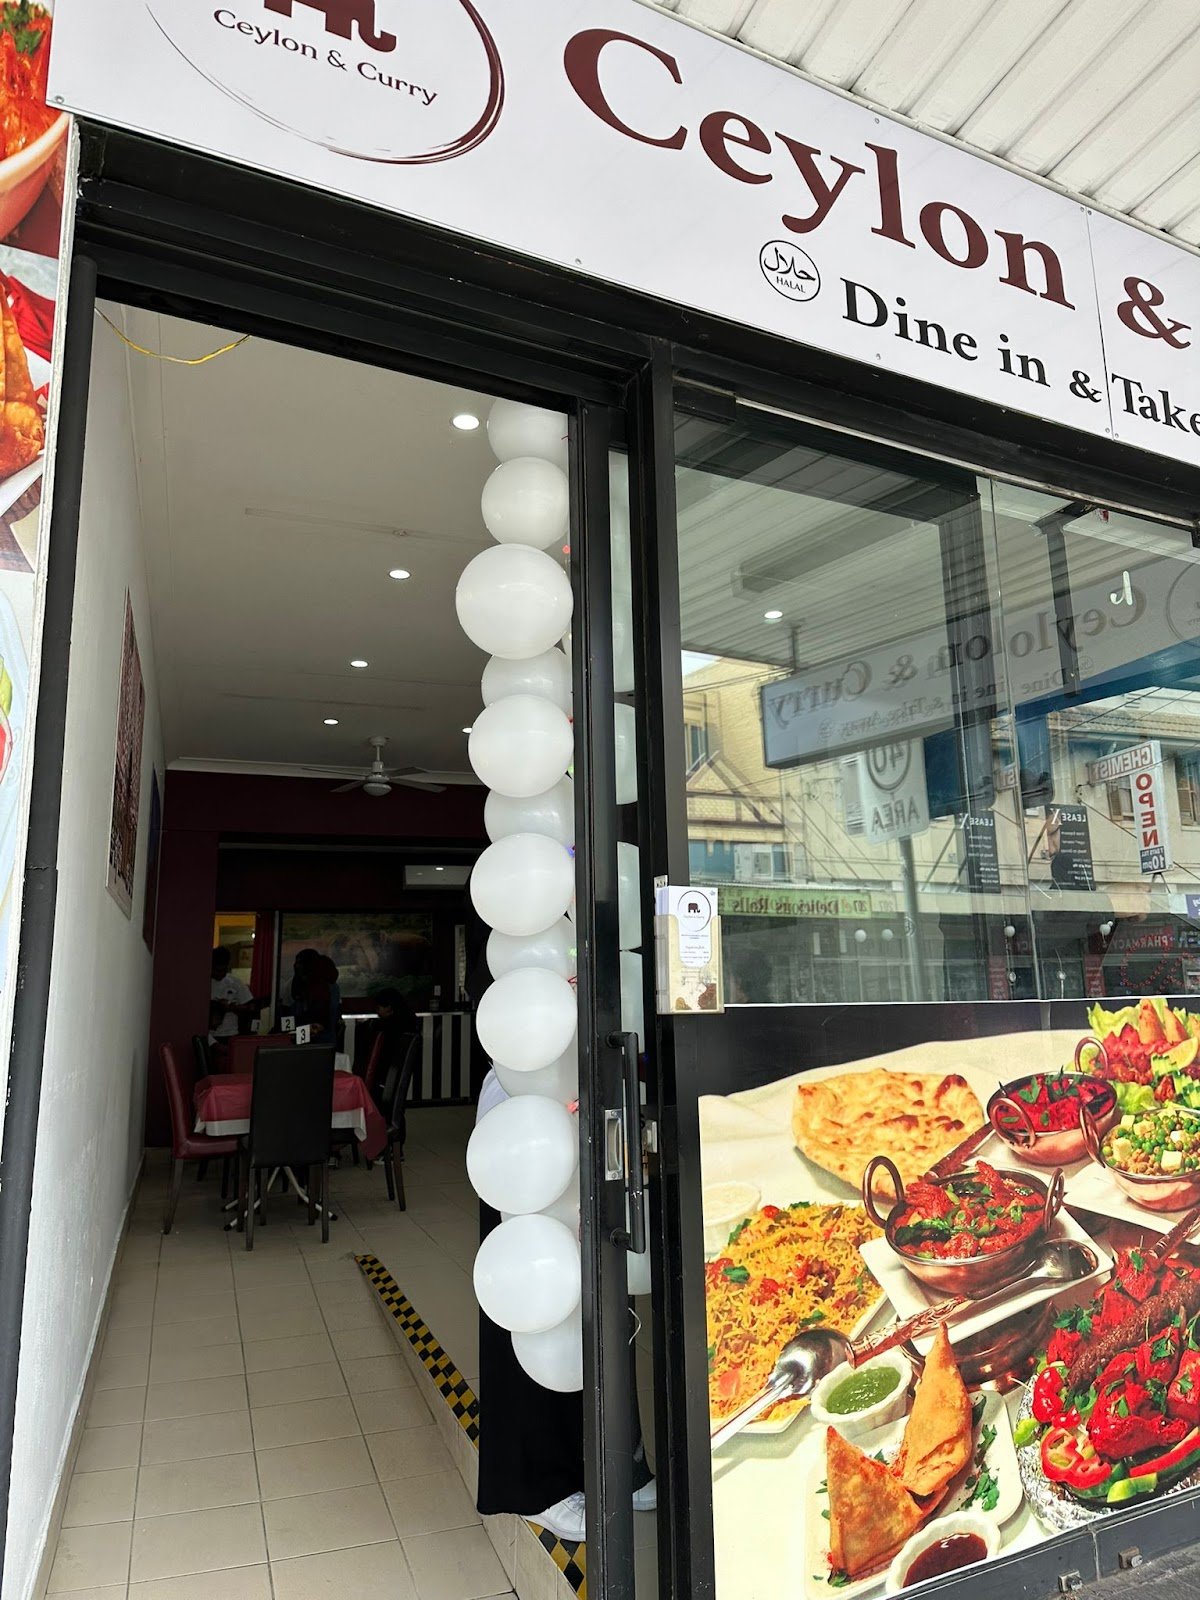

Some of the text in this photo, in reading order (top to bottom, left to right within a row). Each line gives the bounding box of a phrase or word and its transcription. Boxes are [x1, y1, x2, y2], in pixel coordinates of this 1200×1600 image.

[213, 9, 438, 106] Ceylon & Curry
[563, 28, 1192, 350] Ceylon &
[763, 246, 816, 281] حلال
[776, 276, 806, 293] HALAL
[839, 277, 979, 361] Dine
[997, 333, 1051, 388] in
[1068, 370, 1103, 403] &
